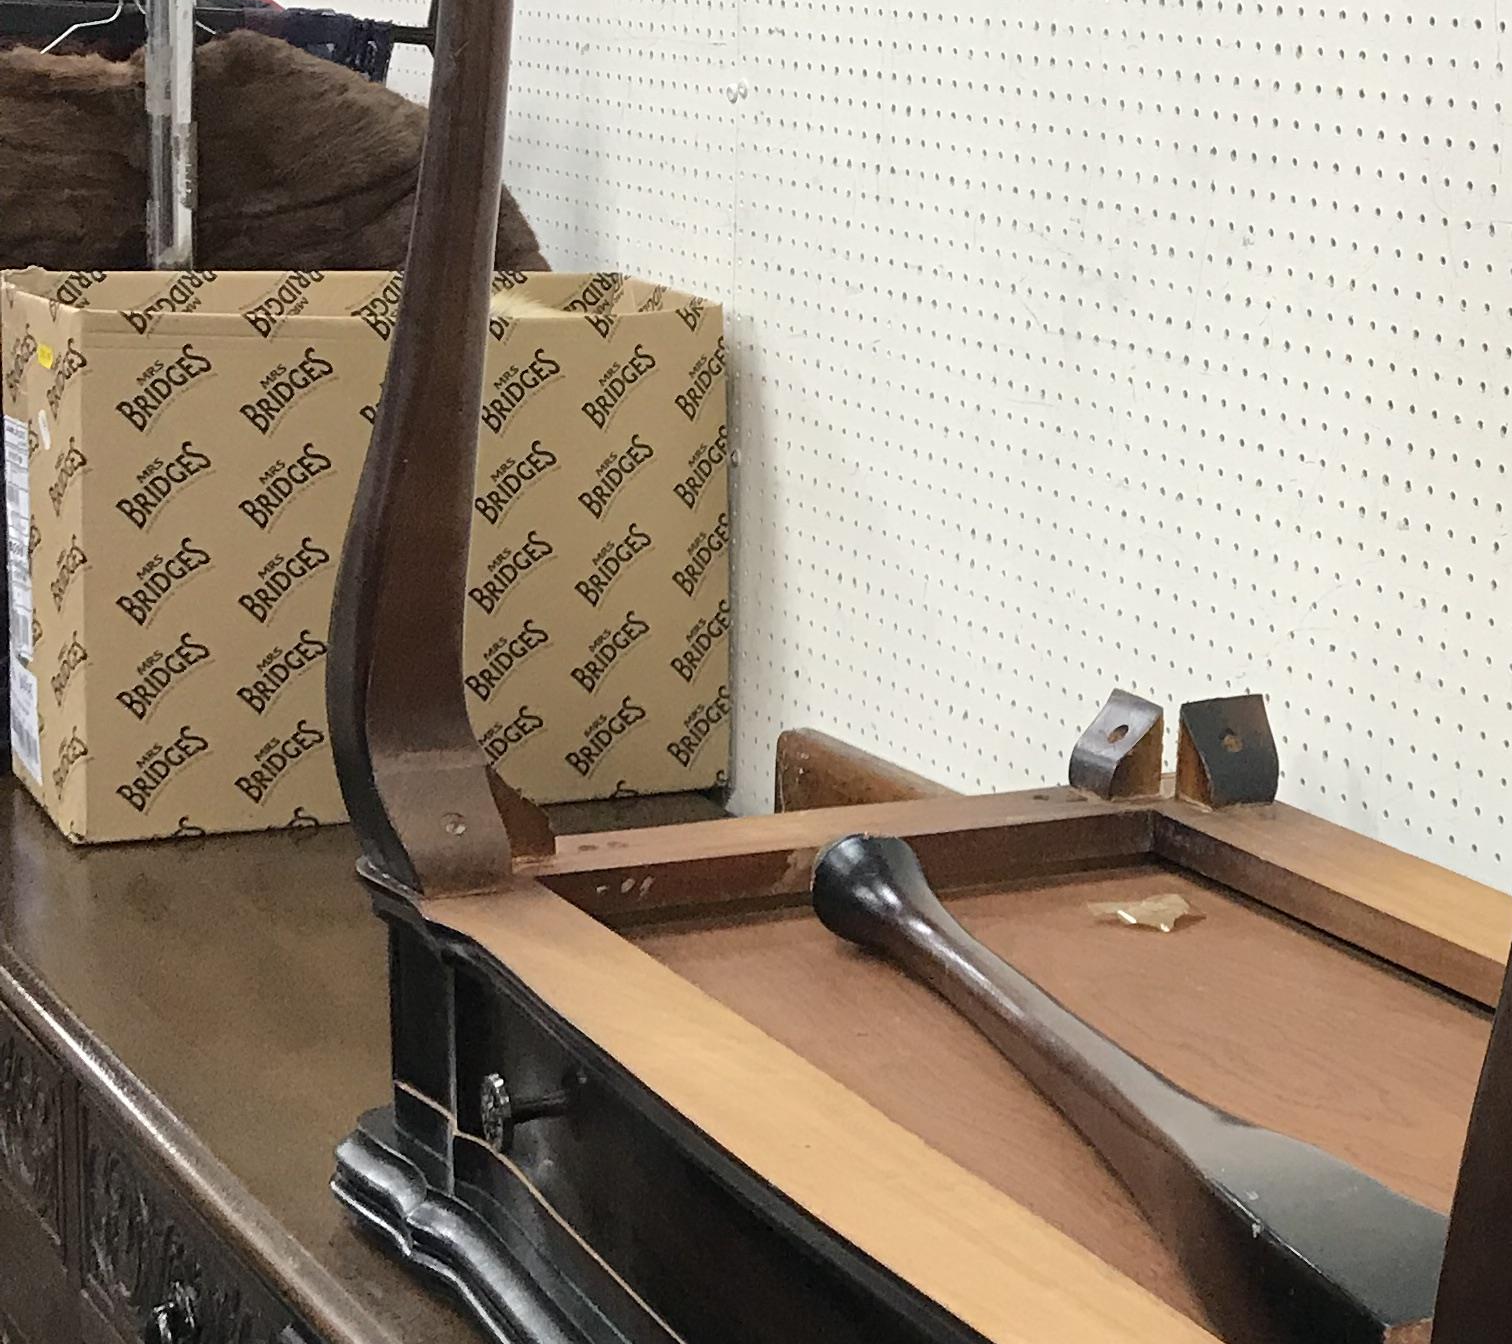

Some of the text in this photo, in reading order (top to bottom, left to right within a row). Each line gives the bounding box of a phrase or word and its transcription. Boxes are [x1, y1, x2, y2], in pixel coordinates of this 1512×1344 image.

[115, 343, 212, 432] BRIDGES
[136, 360, 165, 386] MRS
[239, 347, 333, 435] BRIDGES
[260, 363, 287, 390] MRS
[481, 348, 561, 434] BRIDGES
[493, 365, 520, 390] MRS
[581, 344, 656, 430] BRIDGES
[598, 361, 621, 386] MRS
[115, 441, 211, 529] BRIDGES
[136, 457, 164, 484] MRS
[238, 443, 331, 529] BRIDGES
[258, 459, 286, 485] MRS
[474, 440, 558, 525] BRIDGES
[490, 457, 517, 483] MRS
[577, 434, 654, 519] BRIDGES
[595, 451, 618, 477] MRS
[115, 537, 211, 626] BRIDGES
[136, 554, 164, 580] MRS
[238, 536, 330, 623] BRIDGES
[257, 553, 285, 580] MRS
[468, 530, 553, 615] BRIDGES
[487, 547, 513, 573] MRS
[574, 523, 652, 607] BRIDGES
[116, 632, 210, 721] BRIDGES
[136, 650, 164, 675] MRS
[236, 629, 328, 714] BRIDGES
[256, 646, 283, 673] MRS
[464, 619, 549, 702] BRIDGES
[570, 610, 650, 693] BRIDGES
[115, 725, 209, 812] BRIDGES
[136, 743, 163, 769] MRS
[234, 719, 324, 804] BRIDGES
[484, 705, 544, 765] IDGES
[564, 696, 647, 776] BRIDGES
